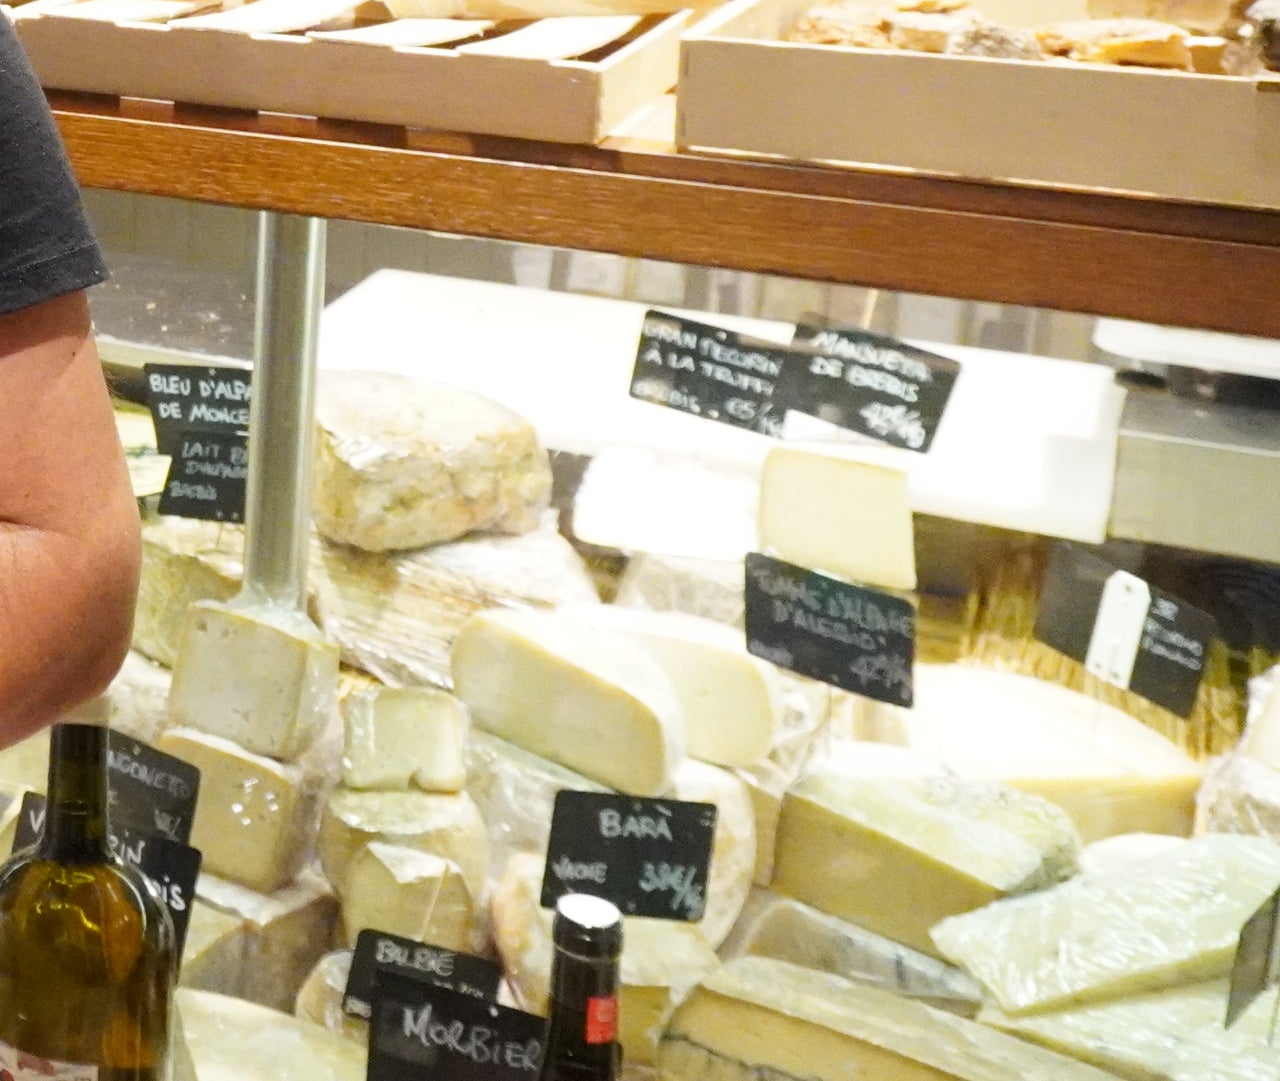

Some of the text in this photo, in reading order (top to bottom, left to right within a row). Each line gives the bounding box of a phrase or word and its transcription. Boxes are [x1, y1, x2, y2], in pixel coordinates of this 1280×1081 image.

[149, 373, 190, 395] BLEU
[158, 402, 249, 425] DE MONCE
